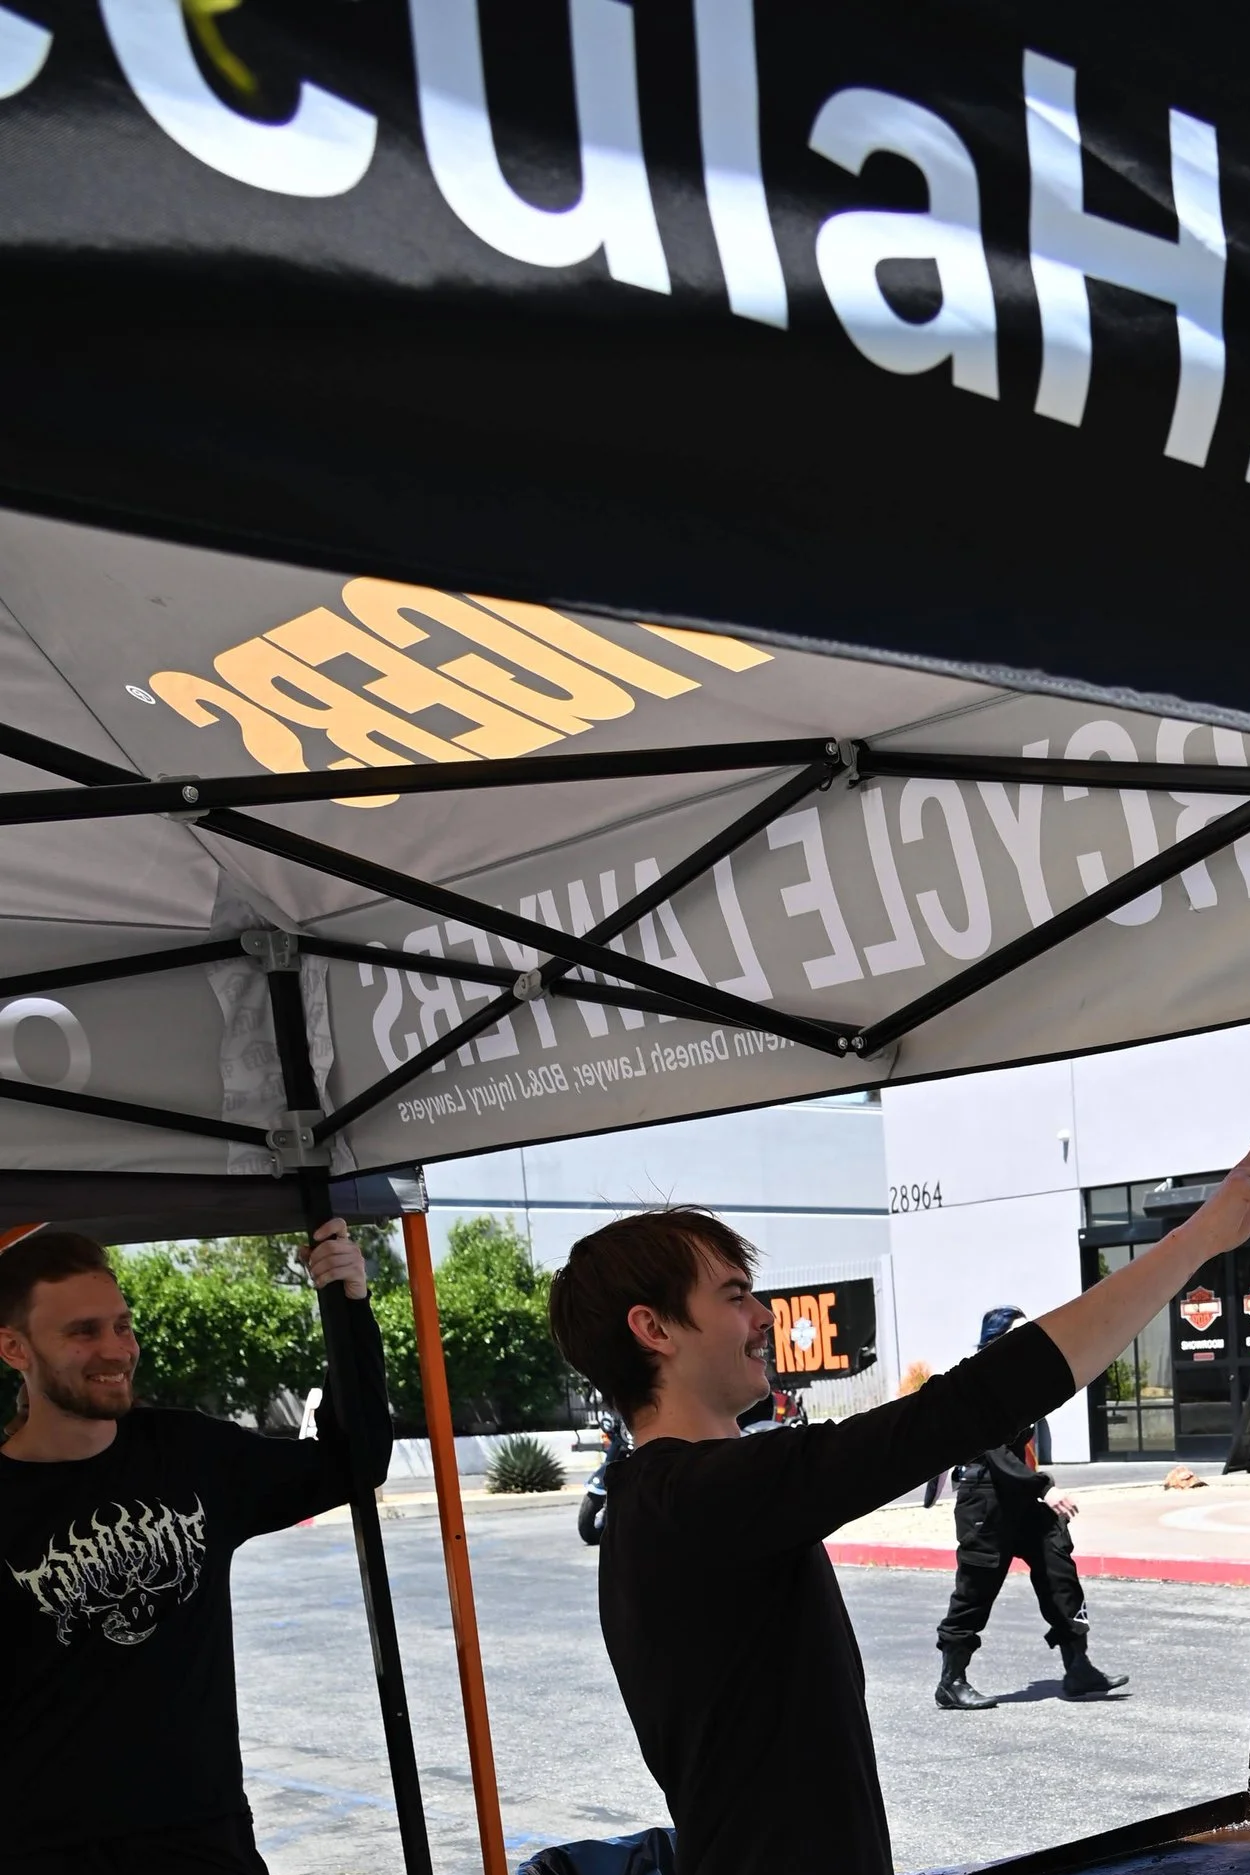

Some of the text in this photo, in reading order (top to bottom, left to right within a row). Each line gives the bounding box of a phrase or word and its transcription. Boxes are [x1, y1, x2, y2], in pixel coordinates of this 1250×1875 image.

[889, 1179, 943, 1214] 28964
[770, 1292, 850, 1374] RIDE.
[1180, 1338, 1225, 1351] SHOWROOM
